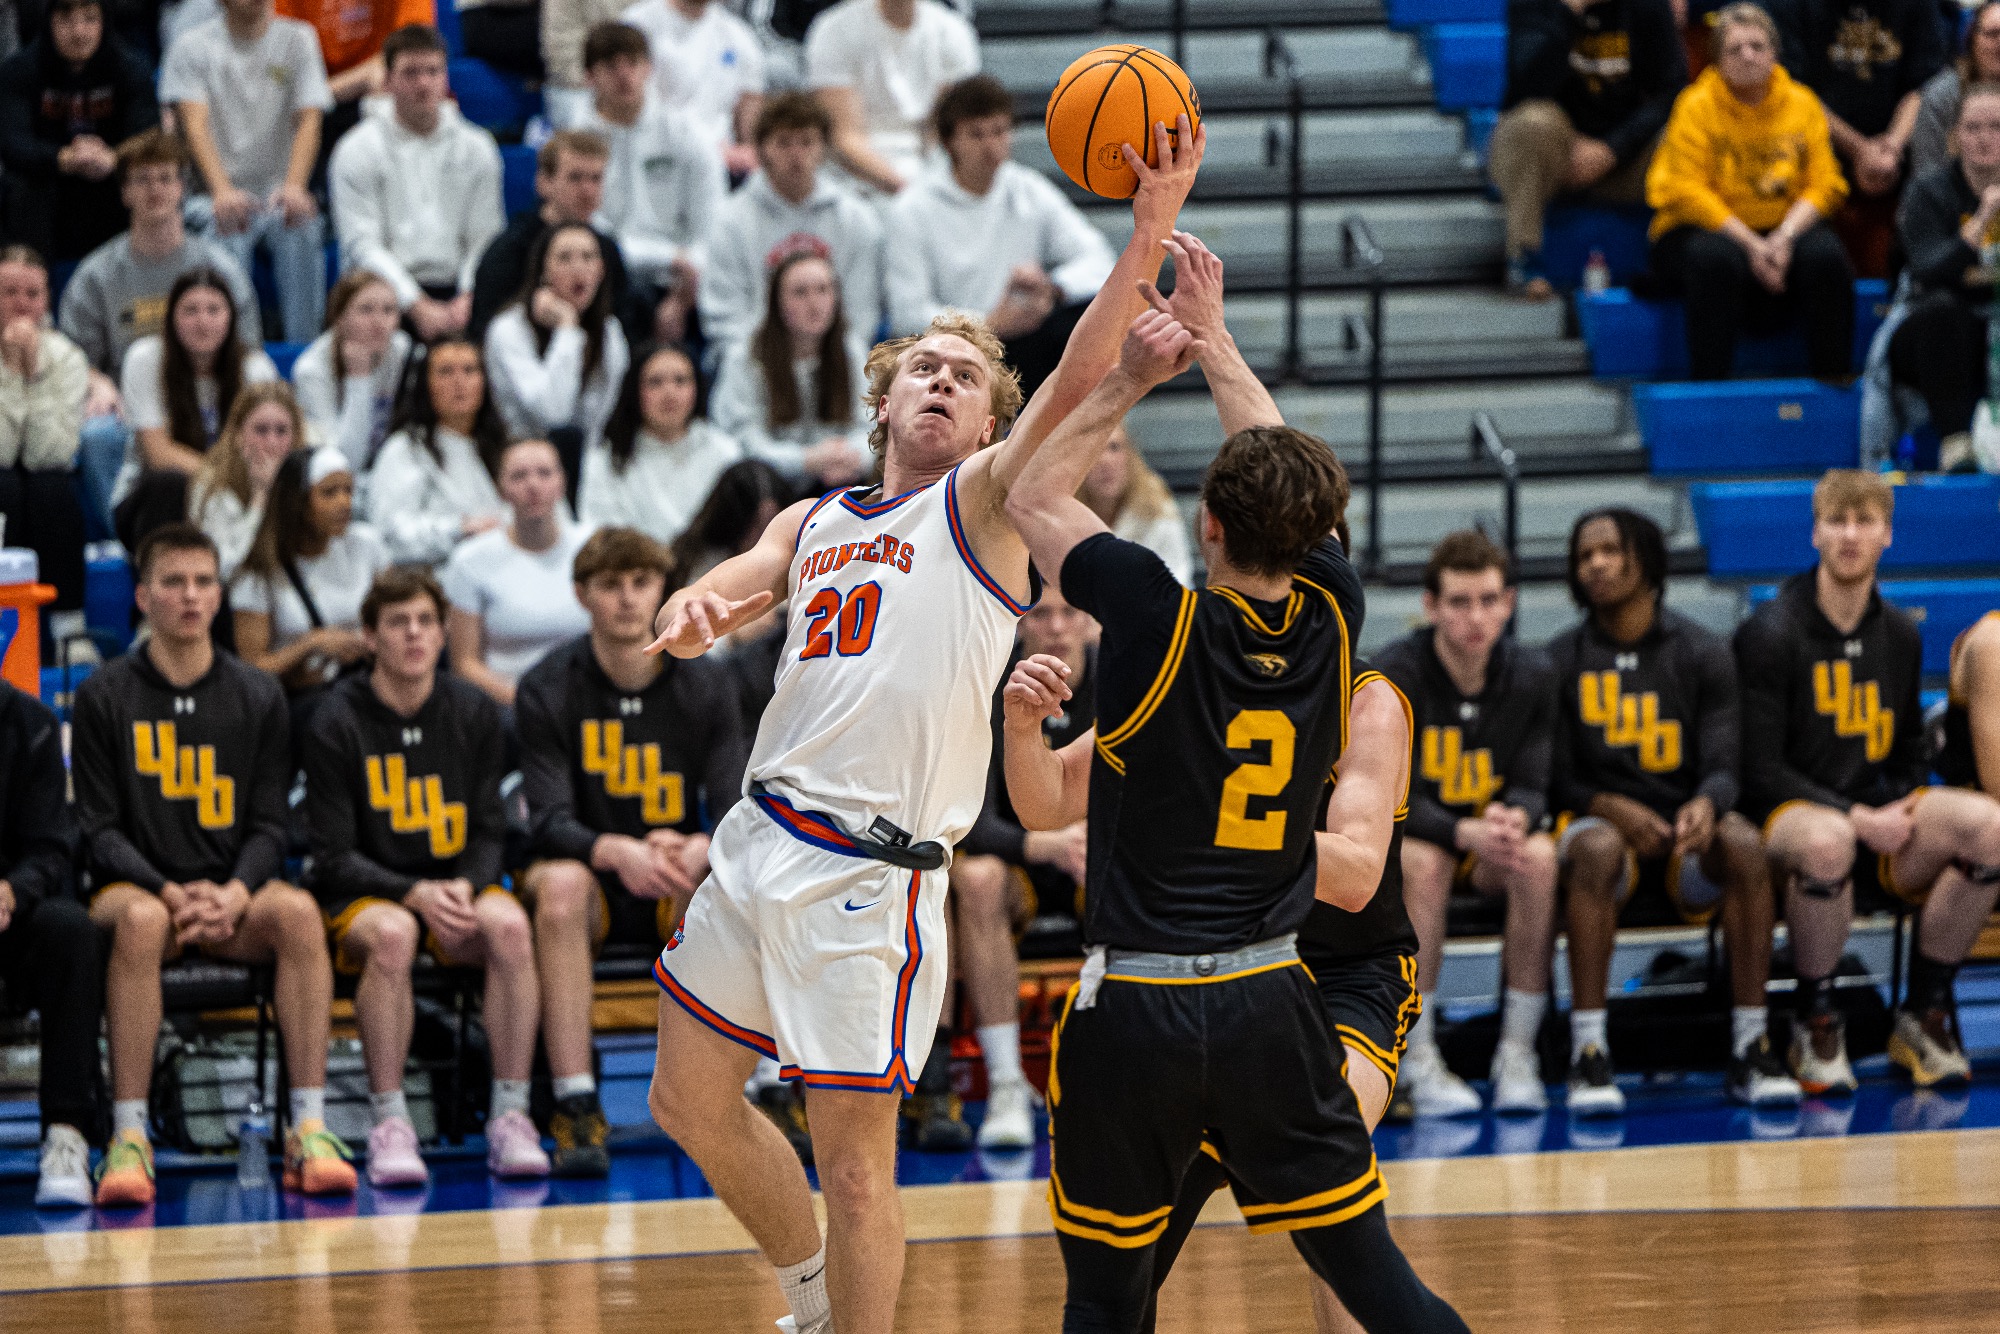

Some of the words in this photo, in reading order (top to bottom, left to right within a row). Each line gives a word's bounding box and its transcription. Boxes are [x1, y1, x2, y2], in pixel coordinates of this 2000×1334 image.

[798, 580, 883, 661] 20
[581, 719, 684, 824] UWO
[1579, 671, 1682, 772] UWO
[133, 720, 235, 829] UWO
[365, 753, 468, 859] UWO
[1213, 709, 1297, 850] 2
